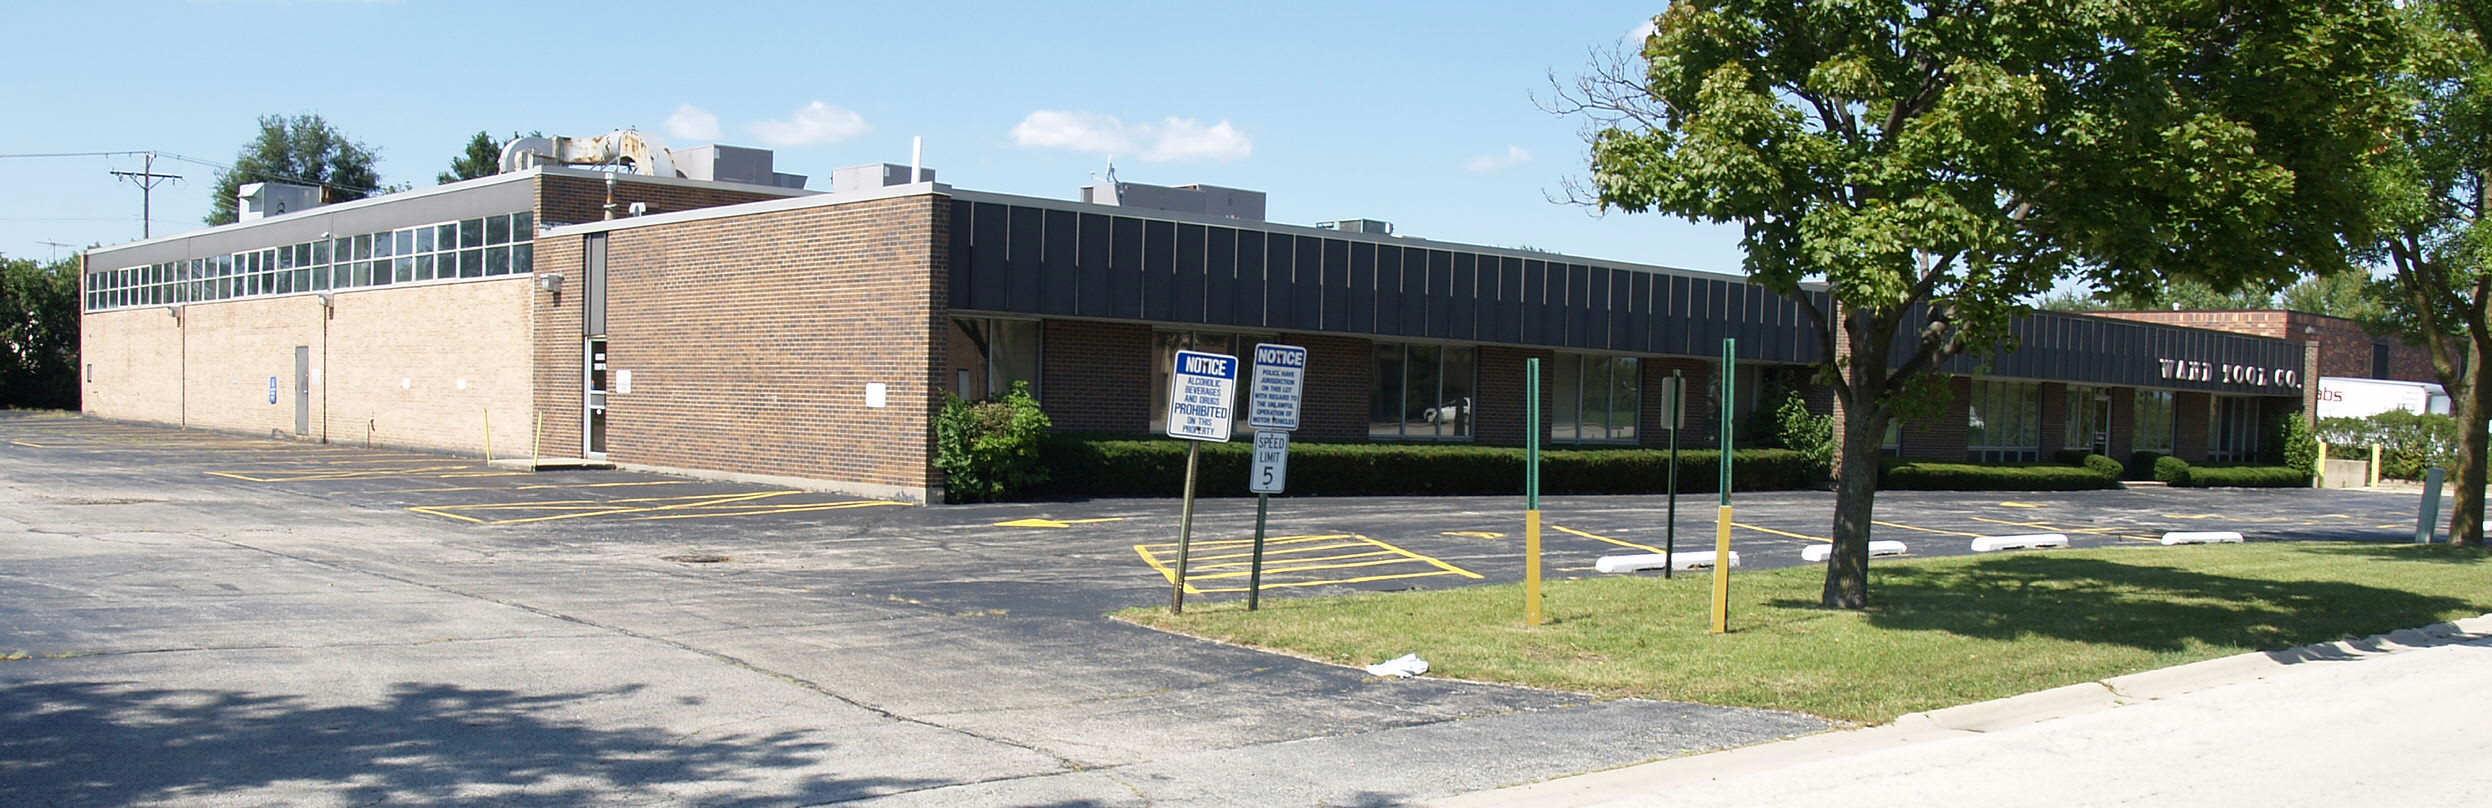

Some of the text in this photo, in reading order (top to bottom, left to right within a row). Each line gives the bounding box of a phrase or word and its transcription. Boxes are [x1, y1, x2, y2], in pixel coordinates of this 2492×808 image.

[1258, 349, 1303, 366] NOTICE
[1185, 356, 1227, 376] NOTICE
[2159, 358, 2303, 389] WARD TOOL CO.
[1188, 377, 1221, 387] ALCOHOLIC
[1185, 386, 1221, 396] BEVERAGES
[1185, 394, 1220, 406] AND DRUGS
[1174, 402, 1228, 419] PROHIBITED
[1187, 416, 1213, 426] ON THIS
[1182, 425, 1215, 436] PROPERTY
[1258, 437, 1285, 449] SPEED
[1259, 451, 1280, 464] LIMIT
[1262, 466, 1274, 486] 5
